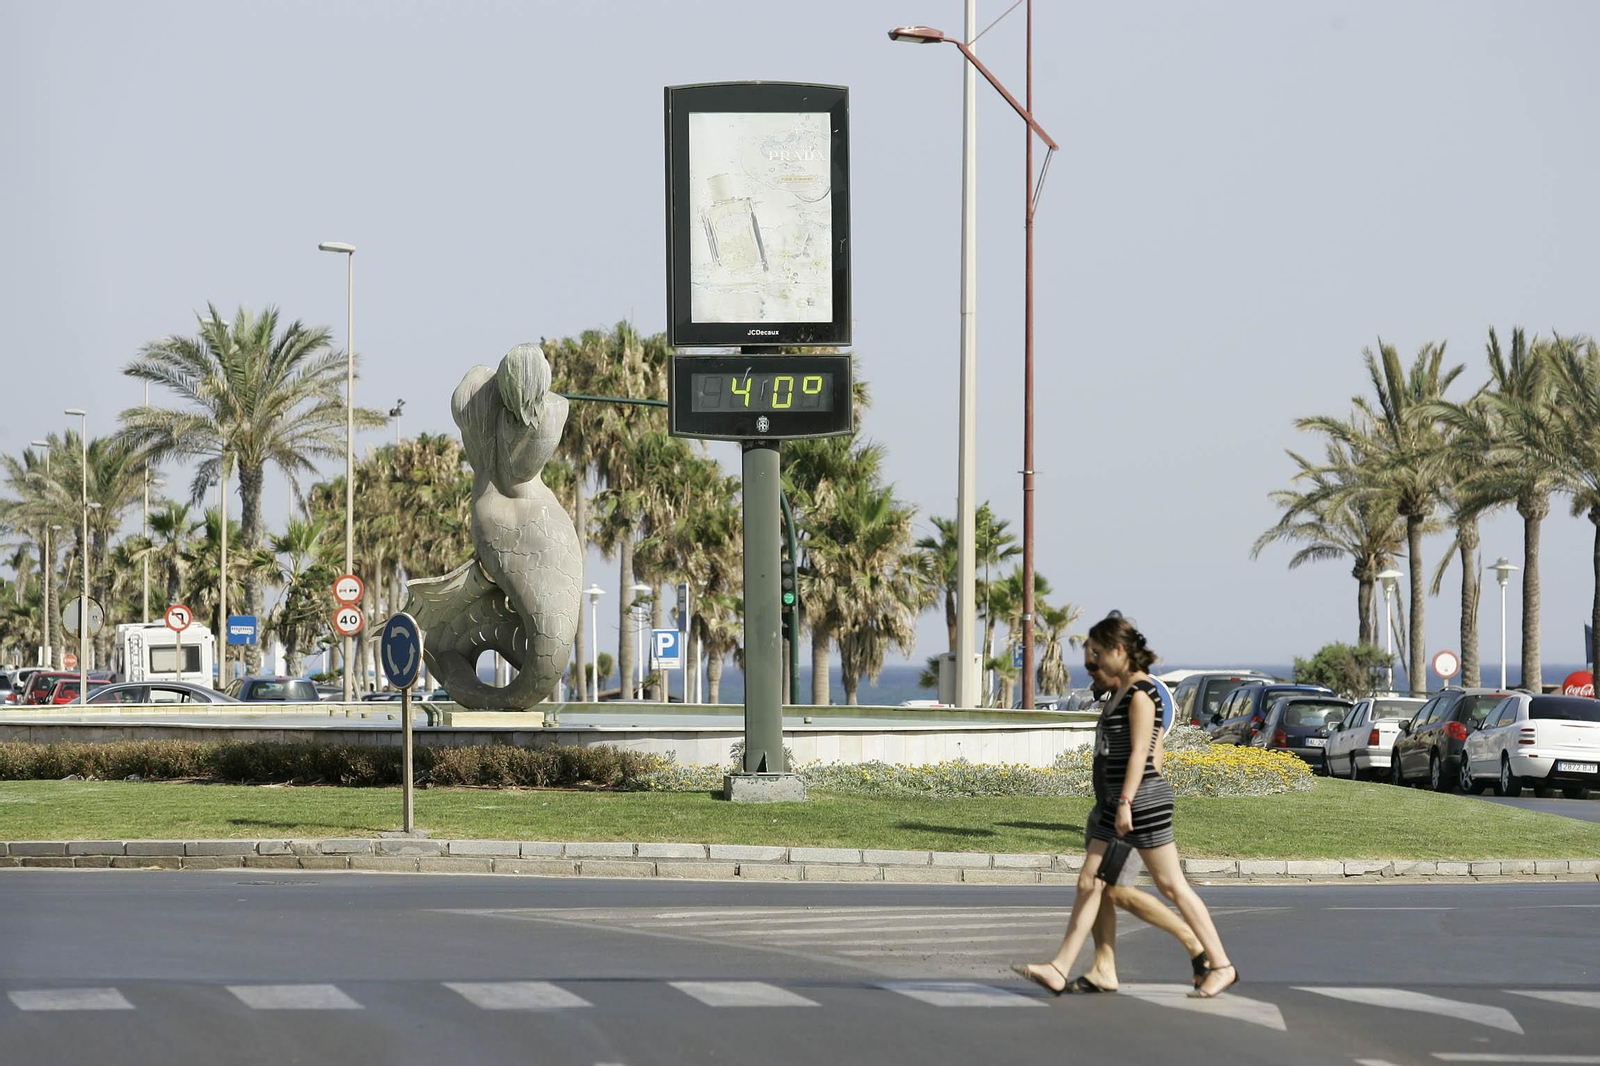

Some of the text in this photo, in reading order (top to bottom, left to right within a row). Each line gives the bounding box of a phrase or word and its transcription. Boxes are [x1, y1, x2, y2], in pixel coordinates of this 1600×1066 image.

[768, 150, 827, 161] PRADA
[340, 615, 358, 626] 40
[657, 632, 675, 656] P
